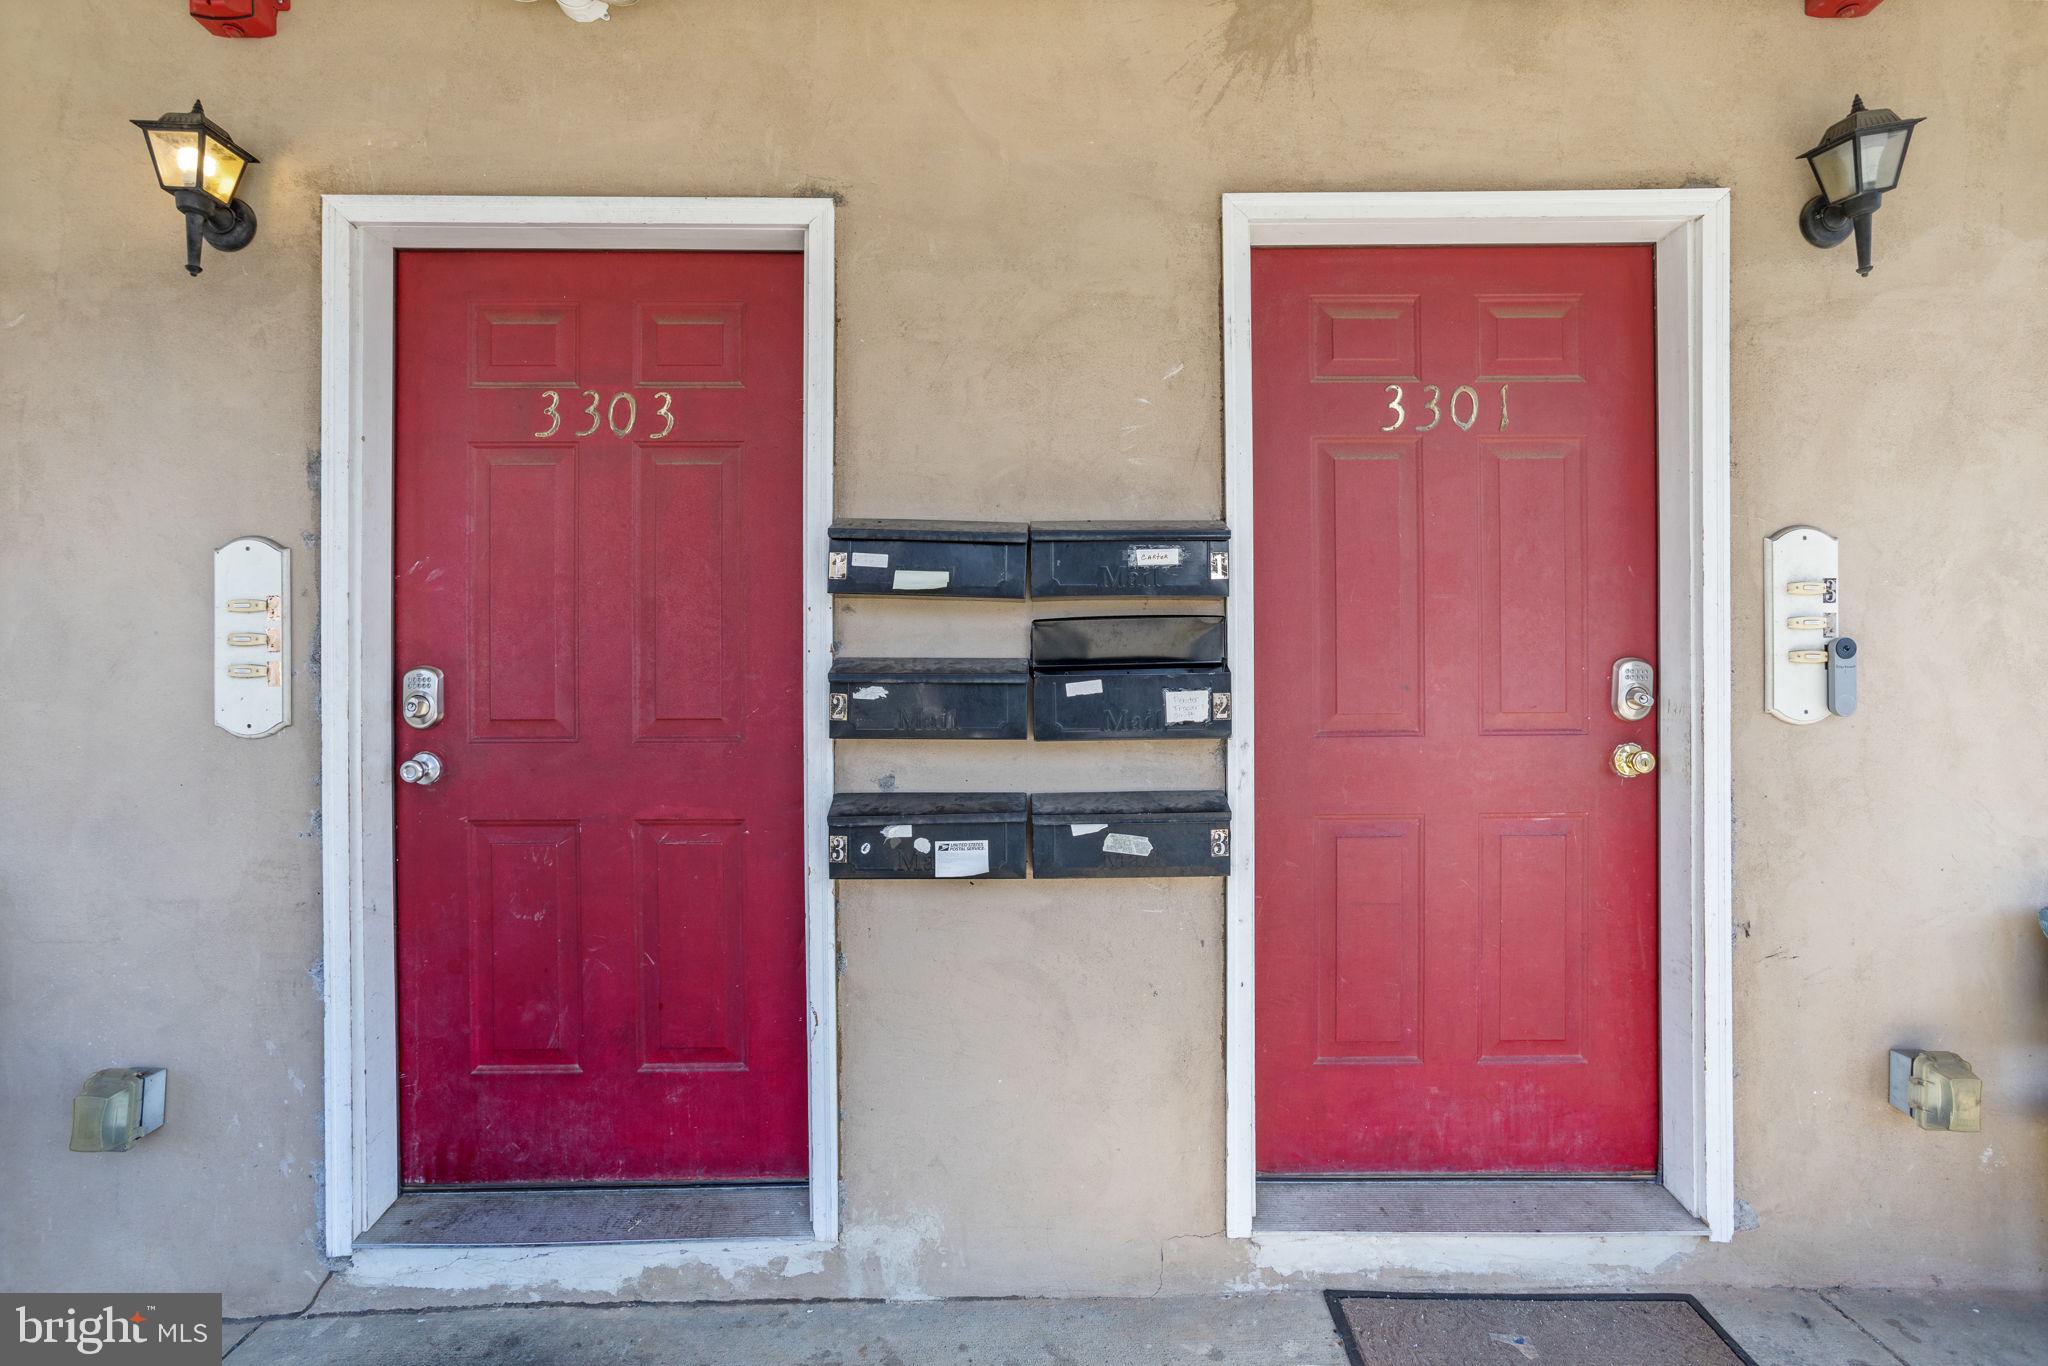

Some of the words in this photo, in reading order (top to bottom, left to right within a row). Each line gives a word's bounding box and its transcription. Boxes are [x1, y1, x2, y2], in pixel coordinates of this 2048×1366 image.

[534, 390, 675, 439] 3303
[1381, 384, 1510, 432] 3301
[1825, 579, 1836, 602] 3
[832, 695, 844, 719] 2
[1216, 694, 1228, 719] 2
[832, 837, 844, 861] 3
[1213, 831, 1226, 855] 3
